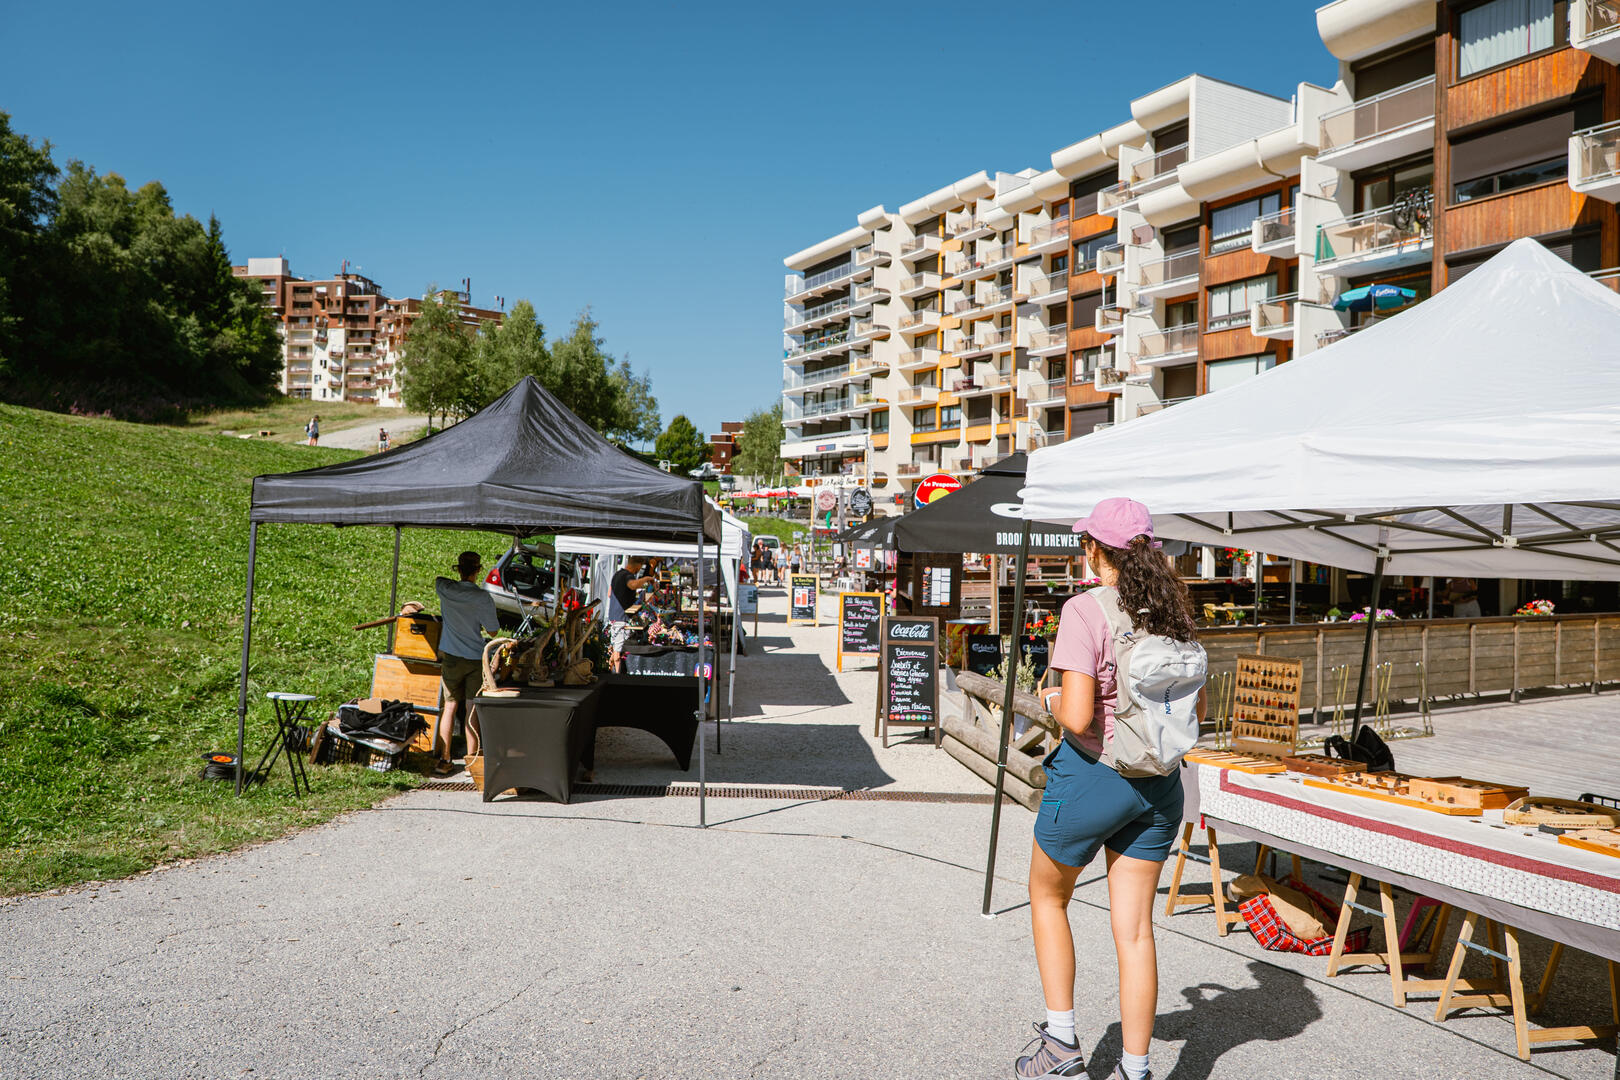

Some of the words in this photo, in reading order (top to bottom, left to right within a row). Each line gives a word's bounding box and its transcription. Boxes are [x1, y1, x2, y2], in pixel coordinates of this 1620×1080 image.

[996, 532, 1042, 547] BROOYN
[1044, 533, 1081, 547] BREWER
[890, 623, 930, 638] Coca-Cola
[971, 643, 998, 653] Carlsberg
[1022, 644, 1048, 654] Crlsberg
